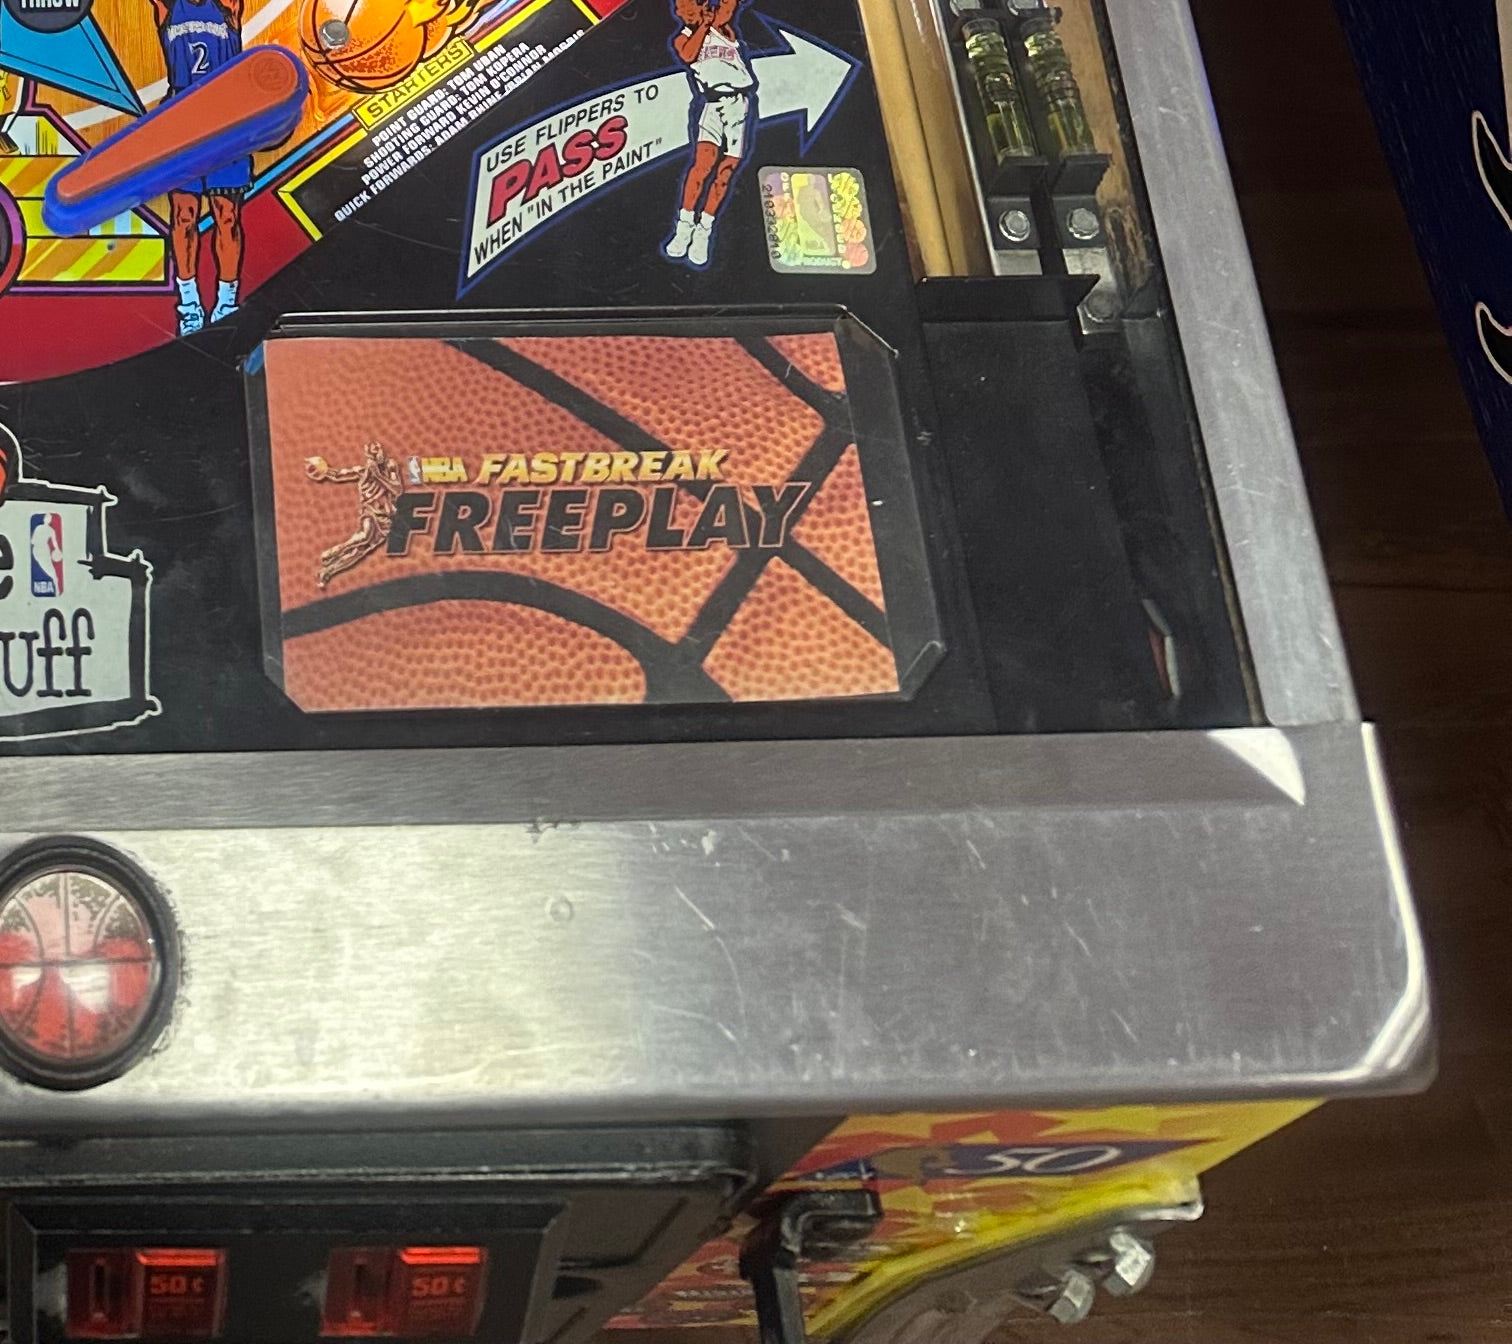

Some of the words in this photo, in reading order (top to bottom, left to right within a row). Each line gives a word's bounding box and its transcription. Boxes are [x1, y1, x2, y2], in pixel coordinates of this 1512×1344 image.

[366, 44, 465, 118] STARTERS
[372, 118, 407, 146] POINT
[407, 87, 449, 121] GUARD:
[487, 139, 526, 173] USE
[536, 95, 625, 146] FLIPPERS
[634, 85, 659, 104] TO
[474, 218, 523, 265] WHEN
[527, 200, 553, 224] "IN
[558, 176, 597, 205] THE
[603, 137, 663, 179] PAINT"
[486, 115, 628, 230] PASS
[420, 455, 467, 483] NBA
[478, 448, 730, 485] FASTBREAK
[385, 480, 812, 555] FREEPLAY
[33, 581, 56, 595] NBA
